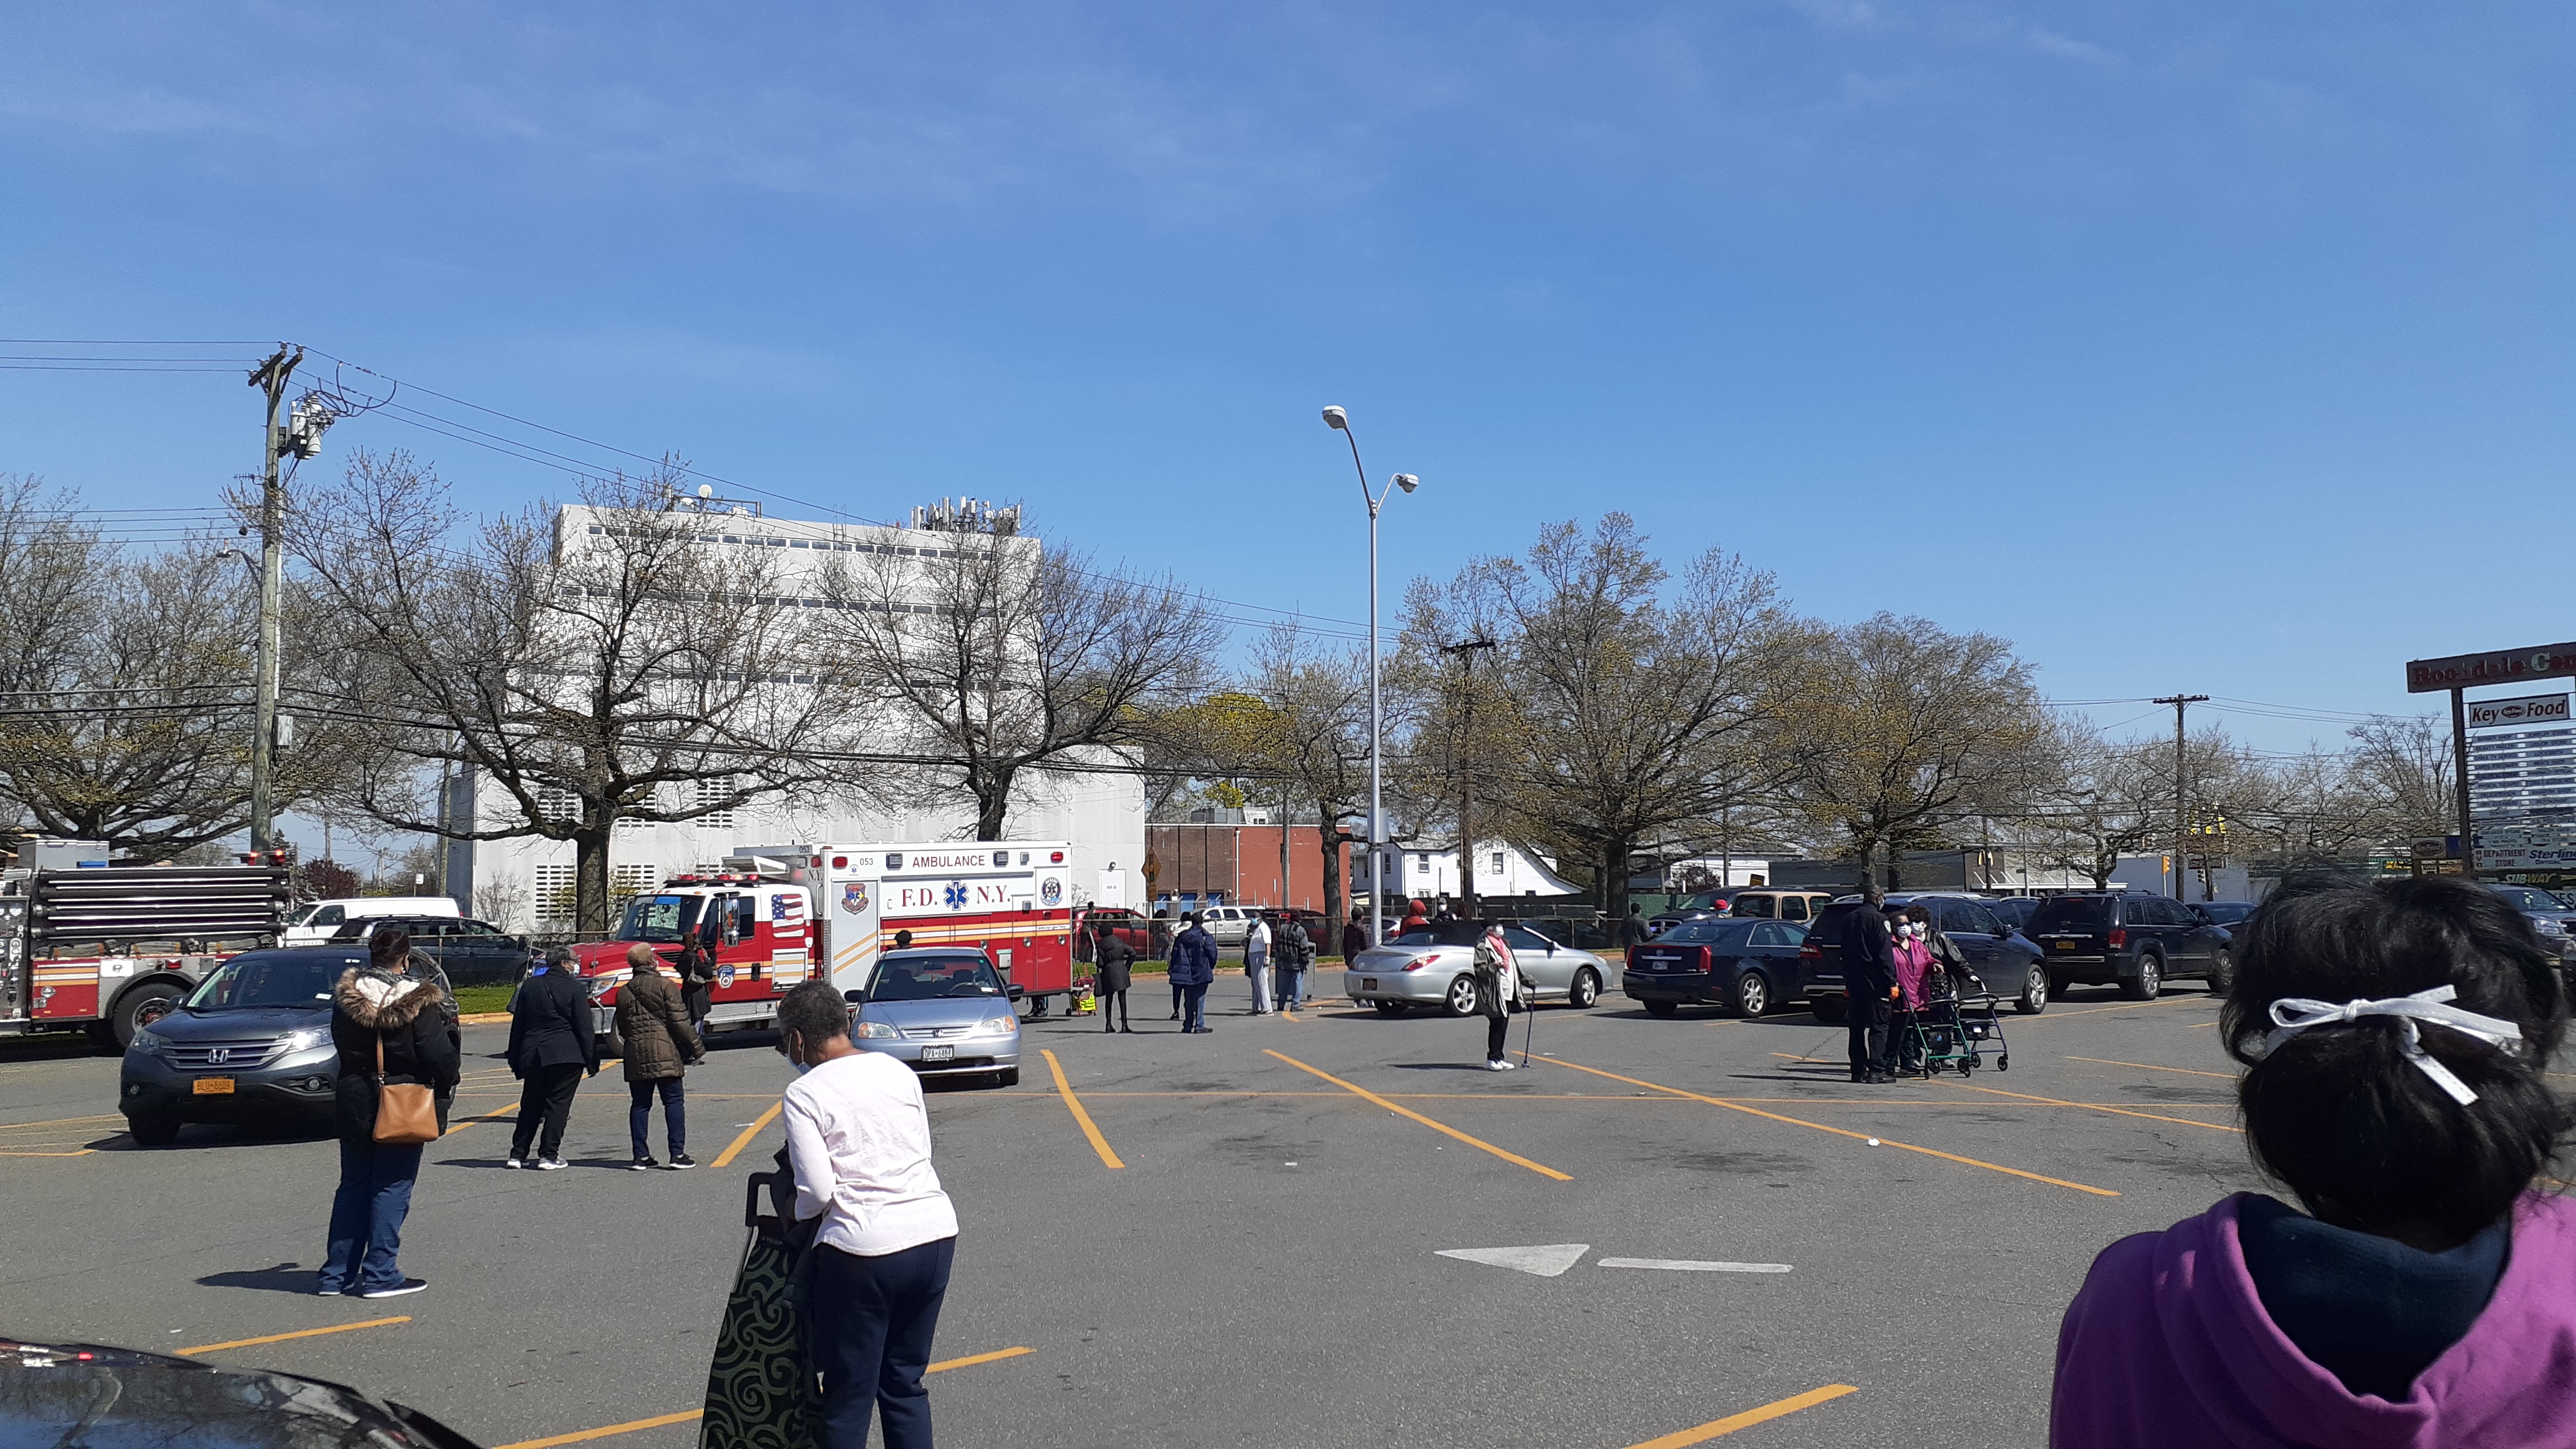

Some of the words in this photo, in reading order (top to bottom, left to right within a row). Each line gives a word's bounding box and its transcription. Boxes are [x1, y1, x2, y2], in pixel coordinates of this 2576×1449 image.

[2472, 707, 2500, 724] Key
[2527, 700, 2567, 717] Food
[2484, 849, 2526, 857] DEPARTMENT
[859, 857, 874, 866] 053
[912, 855, 986, 867] AMBULANCE
[2505, 872, 2557, 884] SUBWAY
[902, 888, 938, 907] F.D.
[977, 885, 1011, 904] N.Y.
